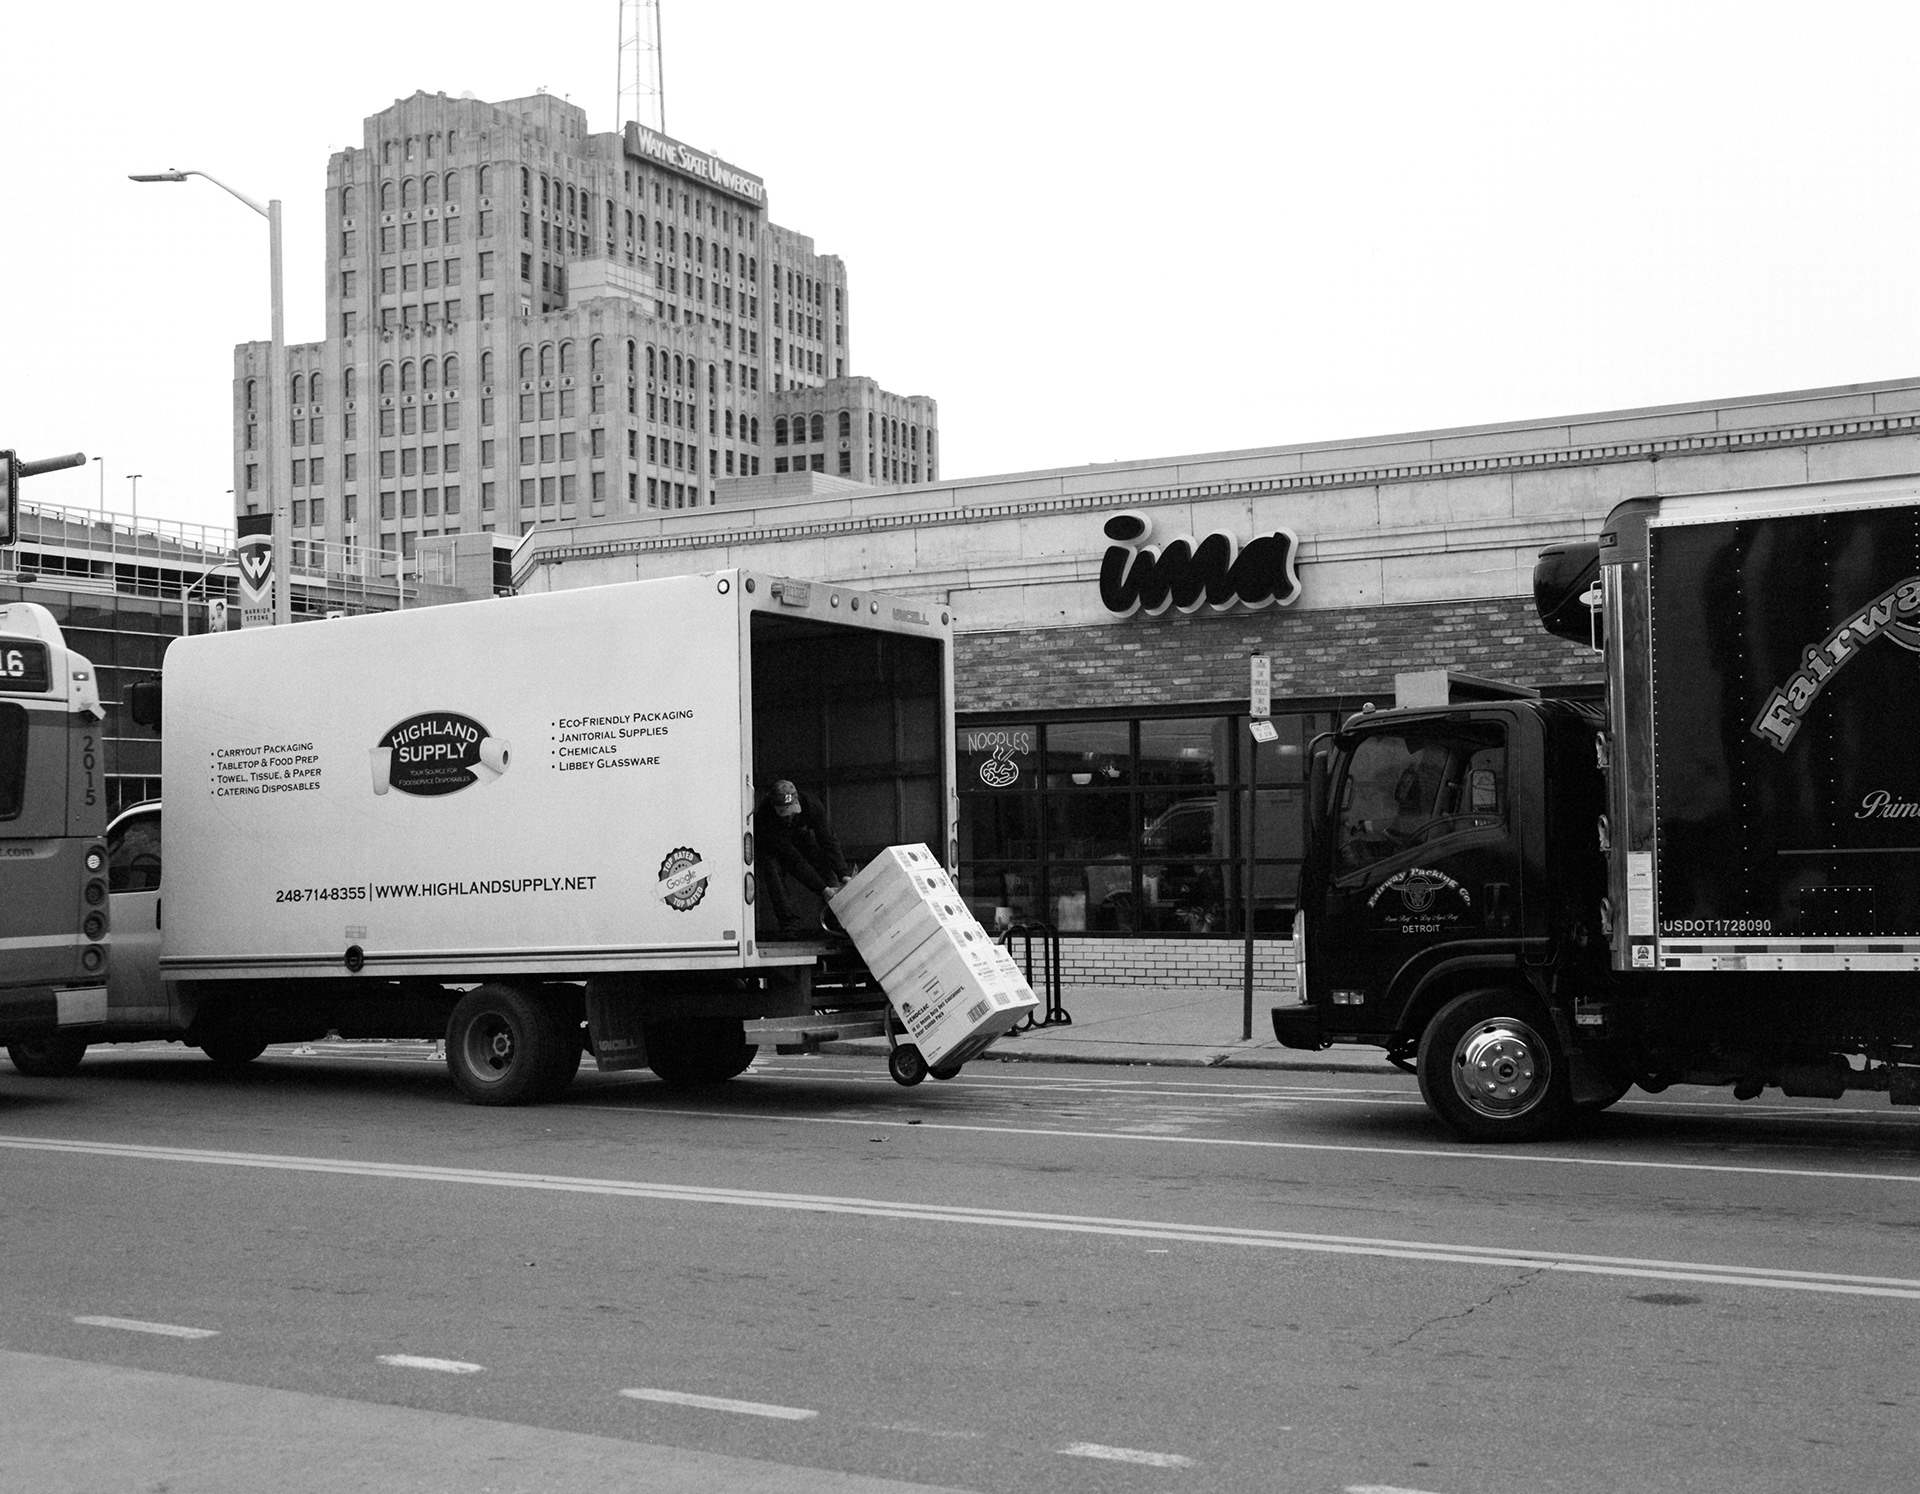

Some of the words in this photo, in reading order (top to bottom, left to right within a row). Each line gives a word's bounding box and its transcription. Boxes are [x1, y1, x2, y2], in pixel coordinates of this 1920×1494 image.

[638, 127, 678, 165] WAYNE
[678, 145, 708, 179] STATE
[708, 158, 763, 201] UNIVERSITY
[1100, 513, 1299, 616] ima
[244, 607, 270, 615] WARRIOR
[246, 614, 269, 622] STRONG
[559, 715, 631, 728] ECO-FRIENDLY
[633, 710, 694, 723] PACKAGING
[392, 720, 478, 749] HIGHLAND
[559, 731, 617, 743] JANITORIAL
[619, 726, 669, 738] SUPPLIES
[217, 747, 262, 758] CARRYOUT
[263, 742, 314, 754] PACKAGING
[399, 742, 468, 763] SUPPLY
[559, 745, 617, 757] CHEMICALS
[968, 732, 1029, 756] NOODLES
[83, 735, 96, 806] 2015
[217, 760, 260, 771] TABLETOP
[261, 758, 268, 767] &
[269, 757, 293, 767] FOOD
[295, 755, 319, 764] PREP
[559, 761, 595, 771] LIBBEY
[596, 756, 661, 769] GLASSWARE
[217, 774, 248, 784] TOWEL,
[250, 772, 282, 781] TISSUE,
[284, 769, 291, 778] &
[293, 768, 322, 778] PAPER
[217, 786, 260, 797] CATERING
[262, 781, 321, 794] DISPOSABLES
[1854, 789, 1920, 819] Prim
[663, 857, 673, 872] TOP
[674, 850, 694, 861] RATED
[666, 870, 697, 889] Google
[1410, 868, 1459, 888] Packing
[275, 886, 367, 903] 248-714-8355
[375, 876, 597, 899] WWW.HIGHLANDSUPPLY.NET
[673, 897, 685, 907] TOP
[686, 886, 703, 906] RATED
[1402, 924, 1440, 934] DETROIT
[1663, 919, 1771, 932] USDOT1728090
